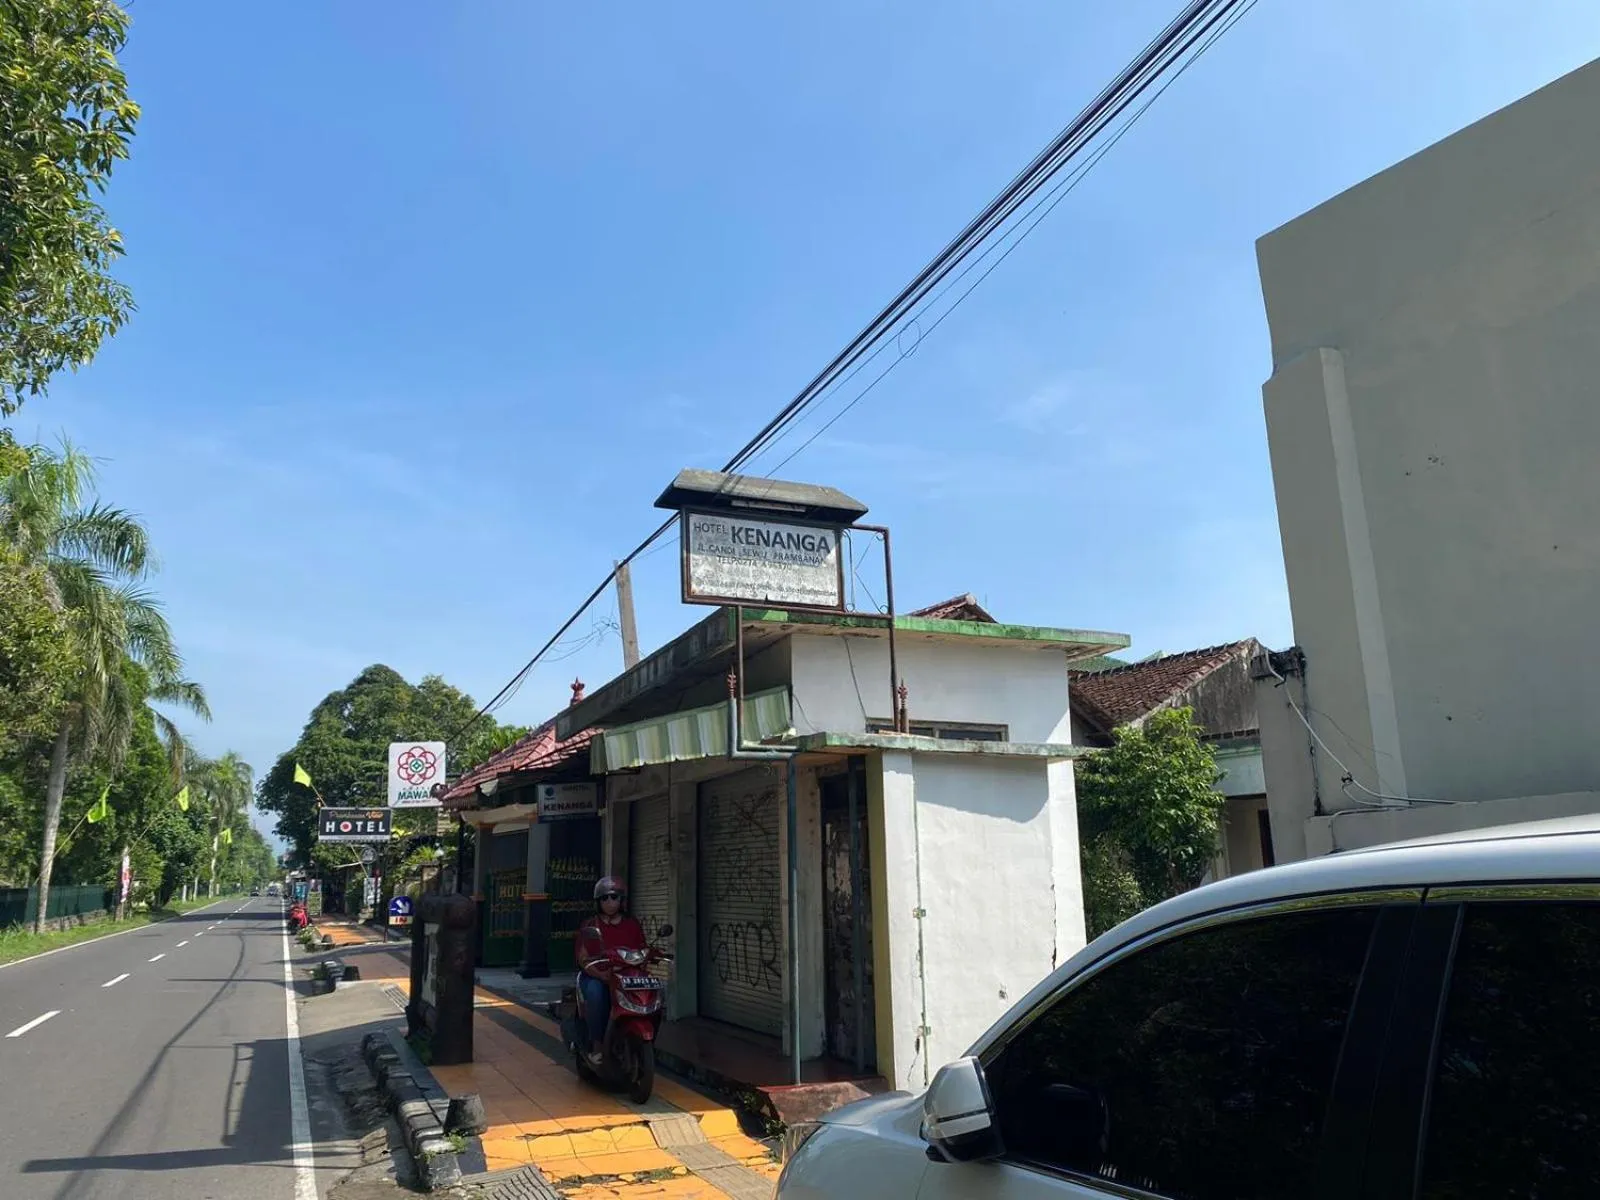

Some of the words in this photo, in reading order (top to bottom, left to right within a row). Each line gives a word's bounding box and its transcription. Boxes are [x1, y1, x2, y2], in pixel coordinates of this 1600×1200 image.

[693, 522, 728, 535] HOTEL
[731, 525, 831, 554] KENANGA
[398, 790, 432, 800] MAWA
[325, 821, 386, 833] HOTEL
